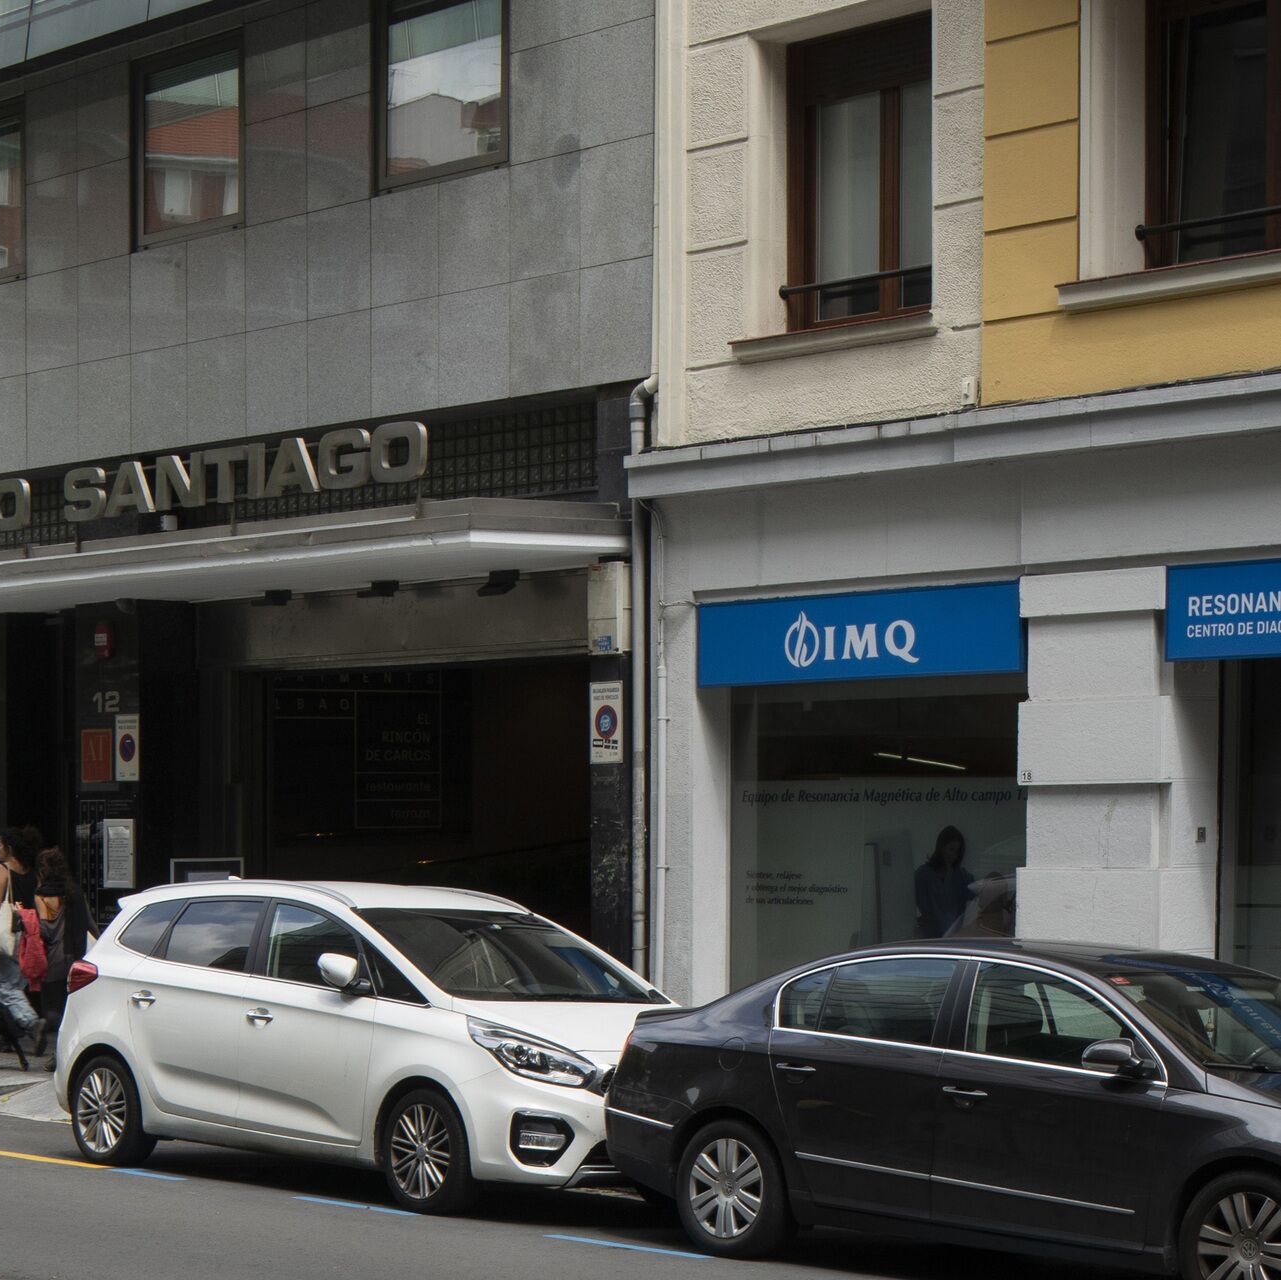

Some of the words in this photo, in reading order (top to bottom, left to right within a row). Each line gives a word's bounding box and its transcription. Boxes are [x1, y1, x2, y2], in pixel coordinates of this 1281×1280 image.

[63, 421, 428, 522] SANTIAGO
[1186, 622, 1234, 638] CENTRO
[1237, 621, 1254, 635] DE
[824, 619, 919, 663] IMQ
[92, 691, 120, 712] 12
[416, 713, 432, 725] EL
[365, 750, 382, 761] DE
[383, 750, 432, 761] CARLOS
[1022, 772, 1032, 781] 18
[742, 789, 778, 807] Equipo
[782, 788, 795, 802] de
[798, 788, 860, 802] Resonancia
[863, 787, 922, 807] Magnética
[925, 787, 940, 802] de
[943, 787, 968, 802] Alto
[971, 790, 1012, 806] campo
